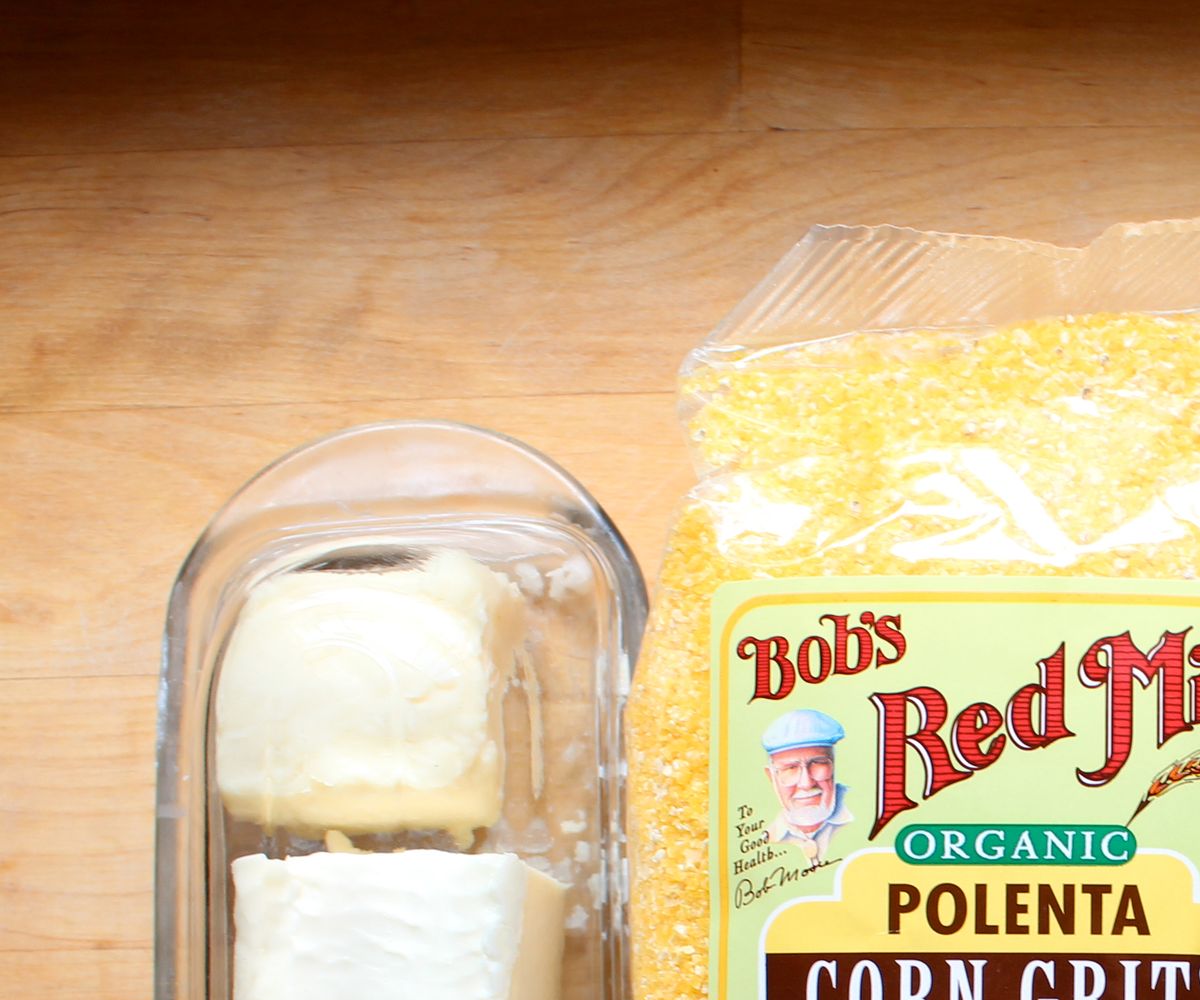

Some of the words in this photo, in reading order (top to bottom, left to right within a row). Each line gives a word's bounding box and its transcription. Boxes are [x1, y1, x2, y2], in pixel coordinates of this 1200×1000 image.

[736, 610, 908, 705] Bob's
[868, 641, 1076, 841] Red
[735, 819, 765, 838] Your
[737, 804, 753, 820] To
[739, 830, 770, 854] Good
[903, 827, 1130, 861] ORGANIC
[887, 882, 1151, 936] POLENTA
